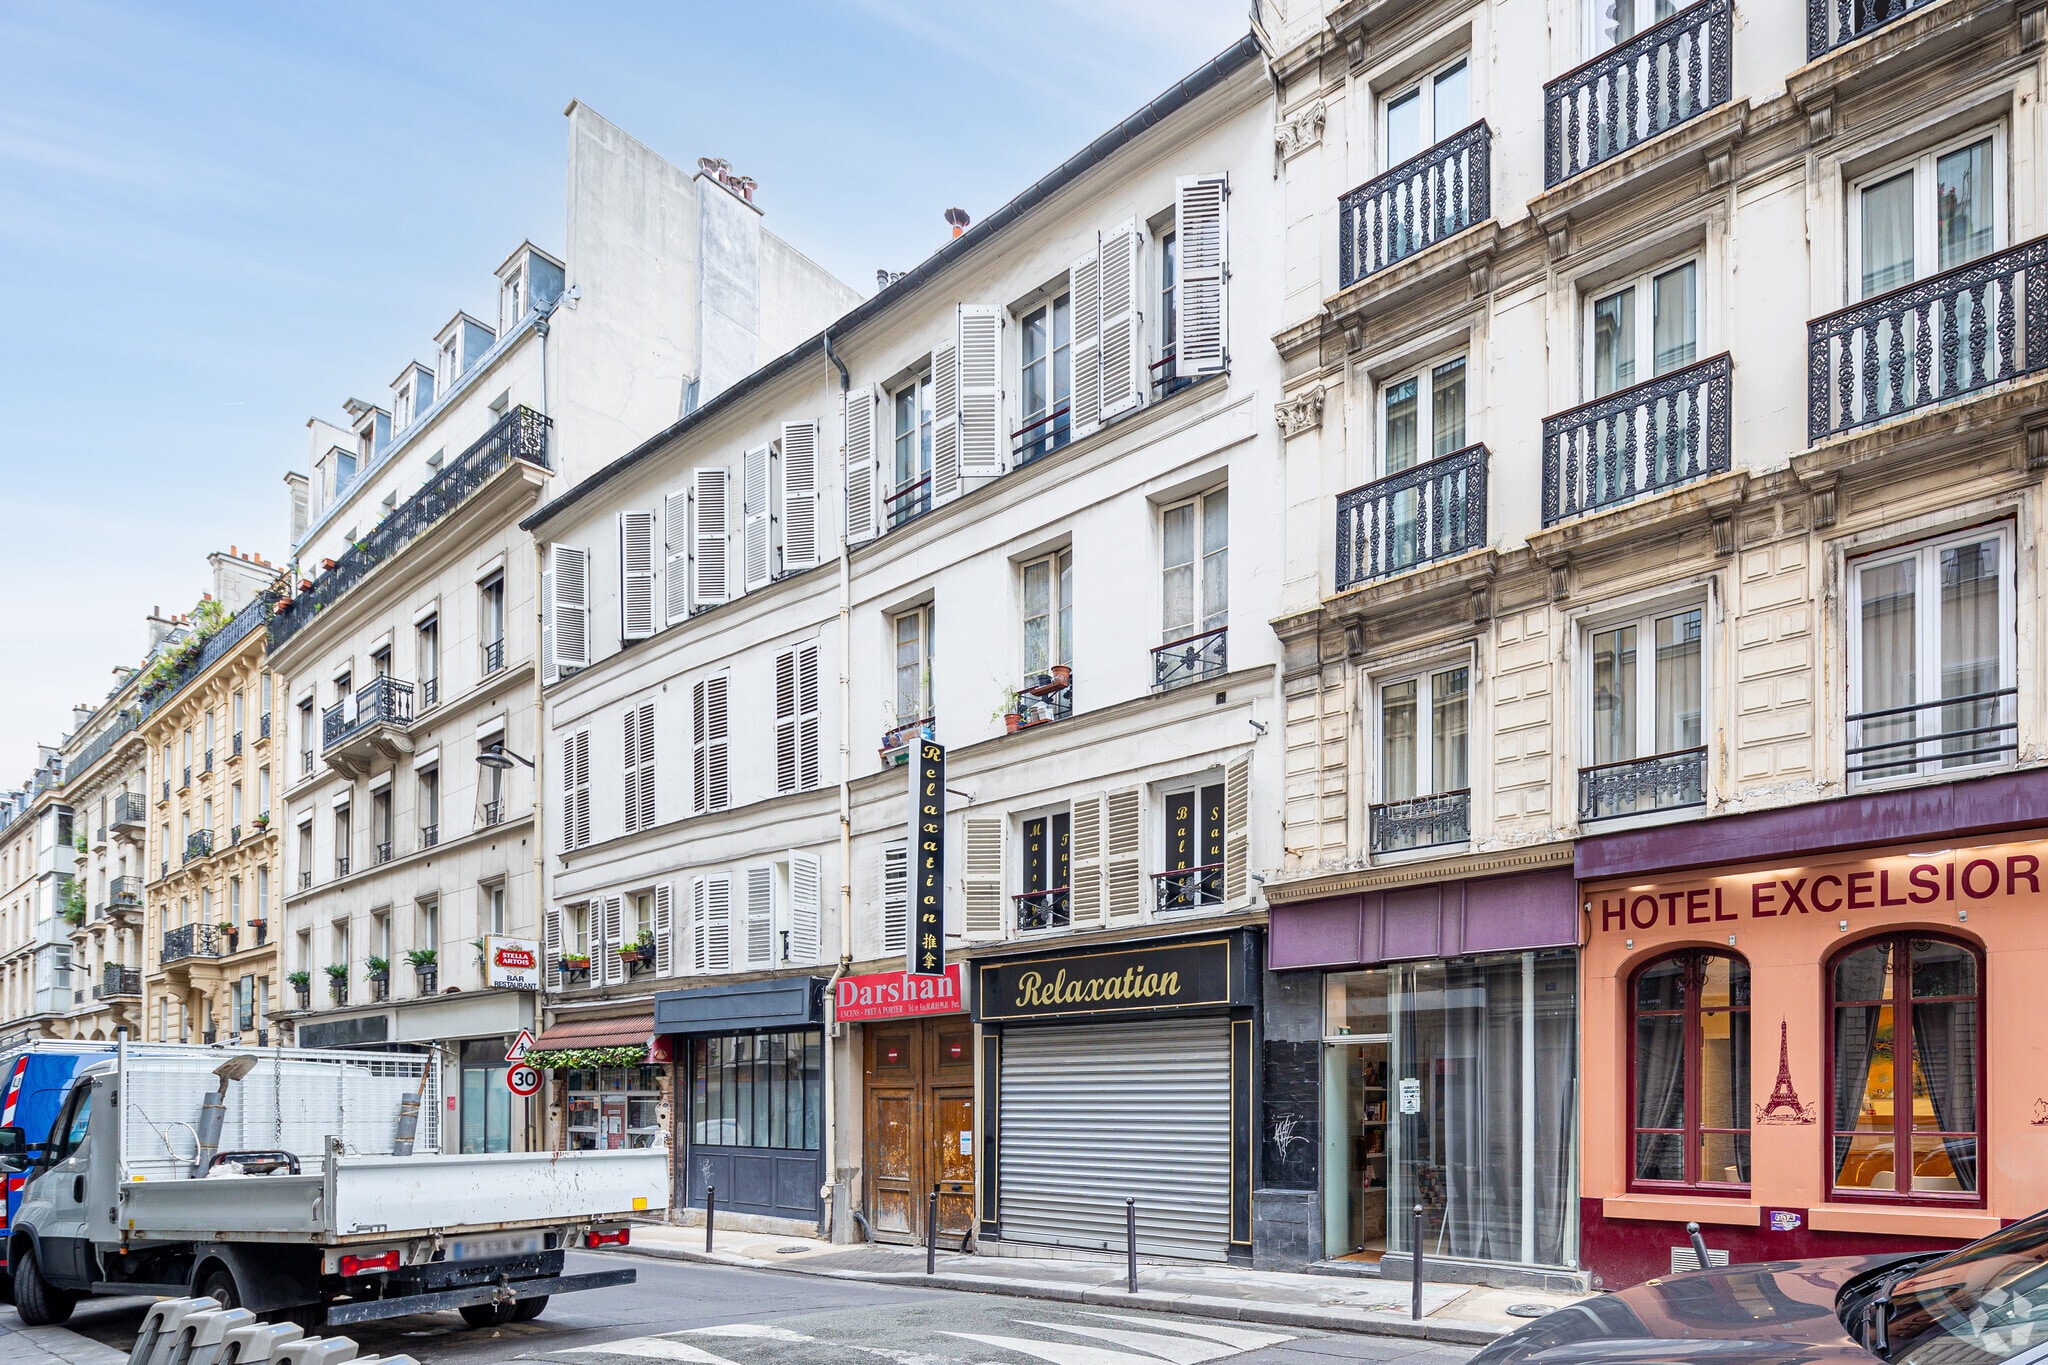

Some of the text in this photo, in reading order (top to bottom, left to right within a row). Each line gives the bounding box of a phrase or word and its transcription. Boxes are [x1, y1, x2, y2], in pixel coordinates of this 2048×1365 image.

[921, 745, 942, 923] Relaxation
[1210, 805, 1220, 889] Sau
[1601, 854, 2042, 932] HOTEL EXCELSIOR
[502, 952, 529, 960] STELLA
[502, 958, 530, 966] ARTOIS
[921, 932, 938, 970] 推拿
[494, 980, 537, 990] RESTAURANT
[837, 974, 953, 1007] Darshan
[1015, 965, 1181, 1007] Relaxation
[883, 1004, 903, 1014] PORTER
[514, 1072, 536, 1087] 30
